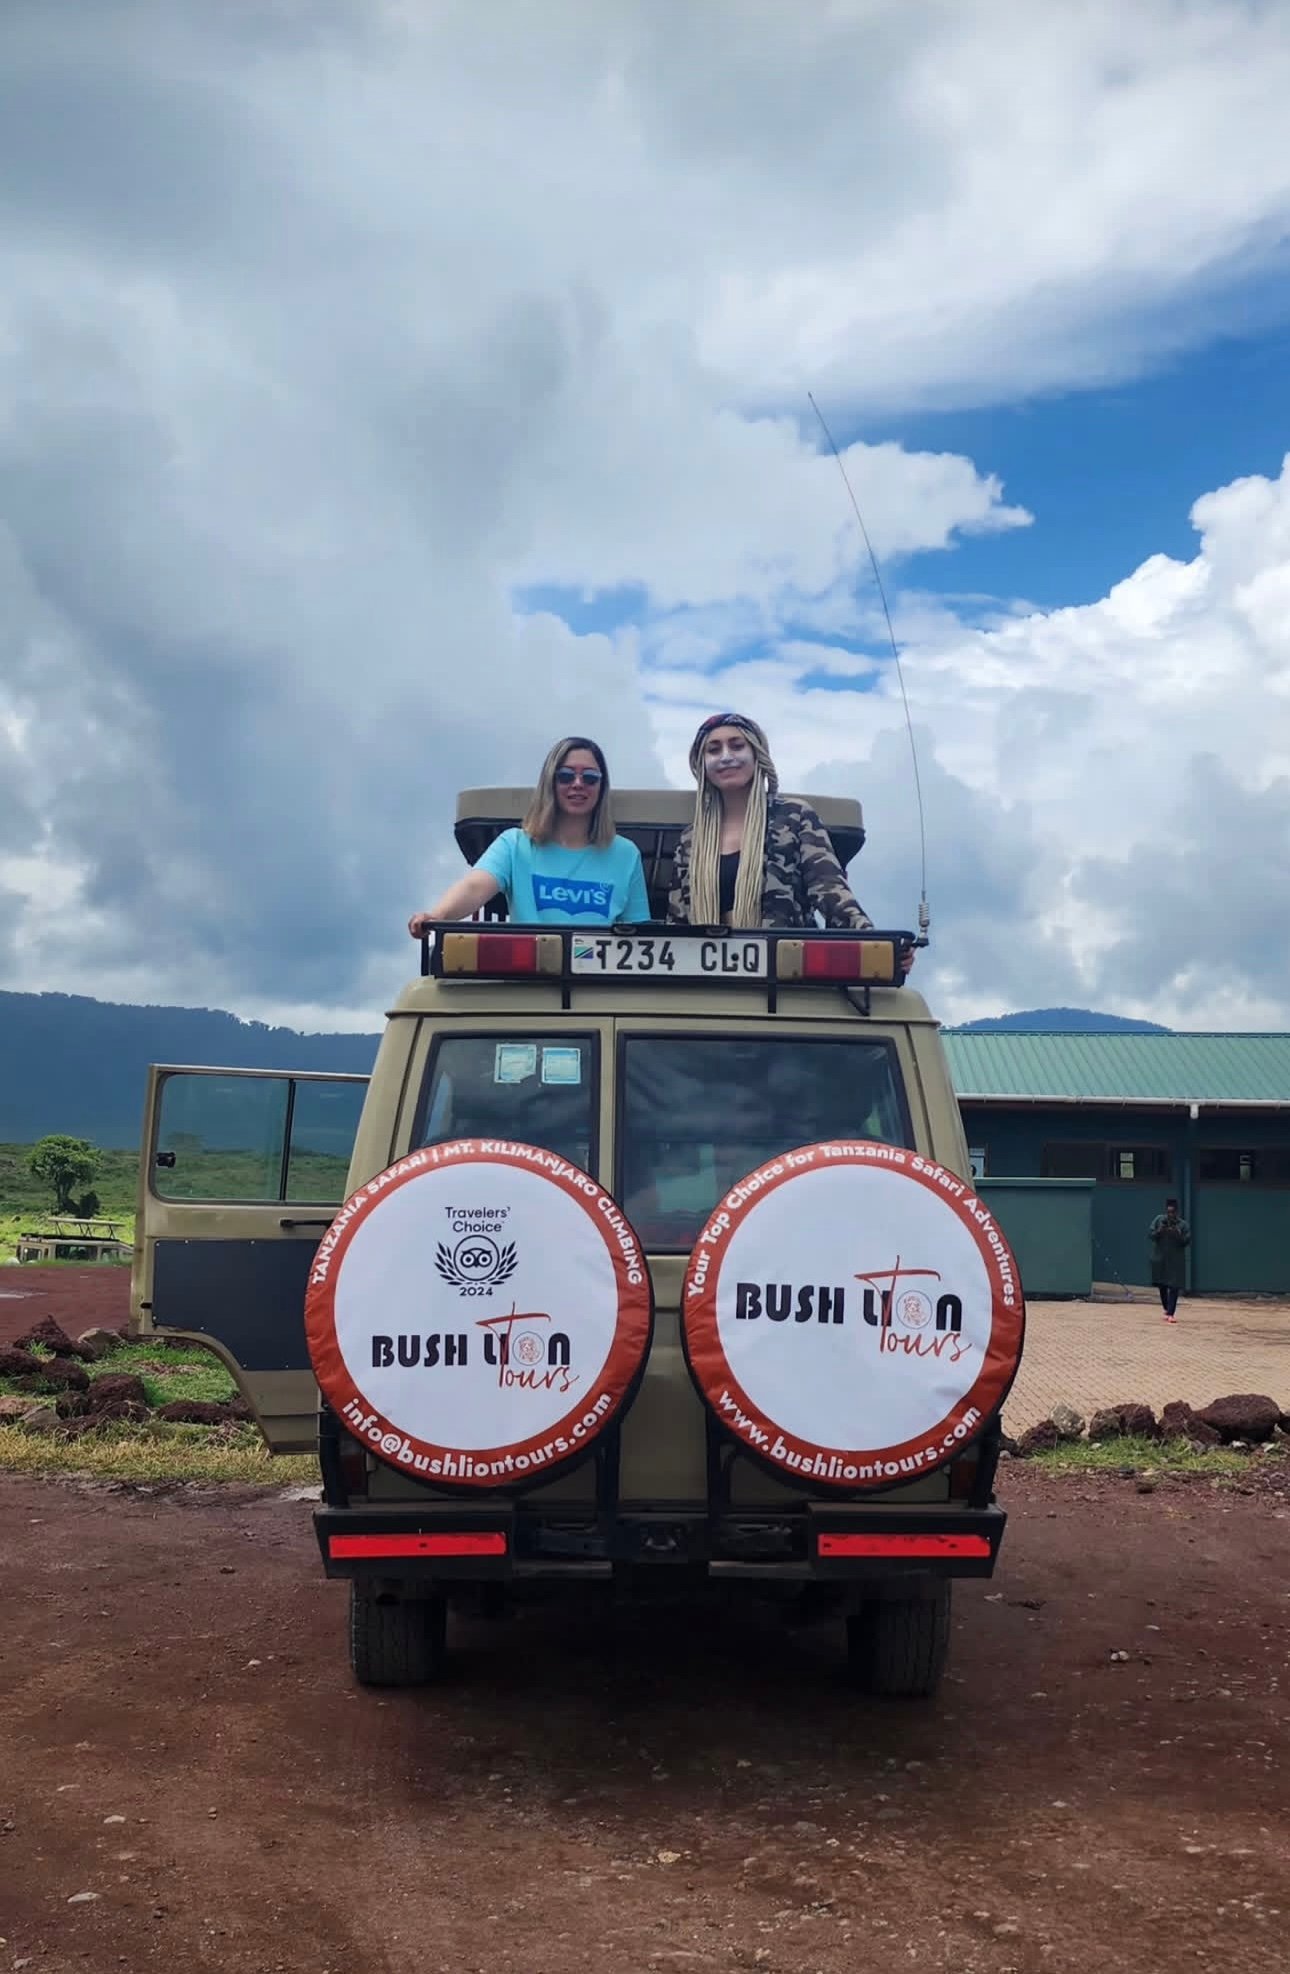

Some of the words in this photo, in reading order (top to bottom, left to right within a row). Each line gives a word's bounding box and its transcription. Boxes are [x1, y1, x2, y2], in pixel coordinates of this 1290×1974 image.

[595, 939, 675, 971] T234
[700, 941, 760, 973] CLQ
[312, 1195, 368, 1284] TANZANIA
[367, 1148, 428, 1195] SAFARI
[443, 1141, 475, 1158] MT.
[480, 1141, 598, 1196] KILIMANJARO
[597, 1196, 643, 1285] CLIMBING
[452, 1220, 503, 1233] Choice
[688, 1249, 711, 1297] Your
[701, 1213, 731, 1246] Top
[727, 1163, 784, 1210] Choice
[785, 1150, 815, 1169] for
[819, 1145, 906, 1164] Tanzania
[911, 1155, 965, 1197] Safari
[963, 1196, 1015, 1307] Adventures
[459, 1286, 494, 1297] 2024
[736, 1282, 845, 1325] BUSH
[854, 1255, 973, 1361] Tours
[372, 1333, 468, 1367] BUSH
[475, 1301, 580, 1392] Tours
[342, 1393, 612, 1478] info@bushliontours.com
[719, 1391, 981, 1480] www.bushliontours.com
